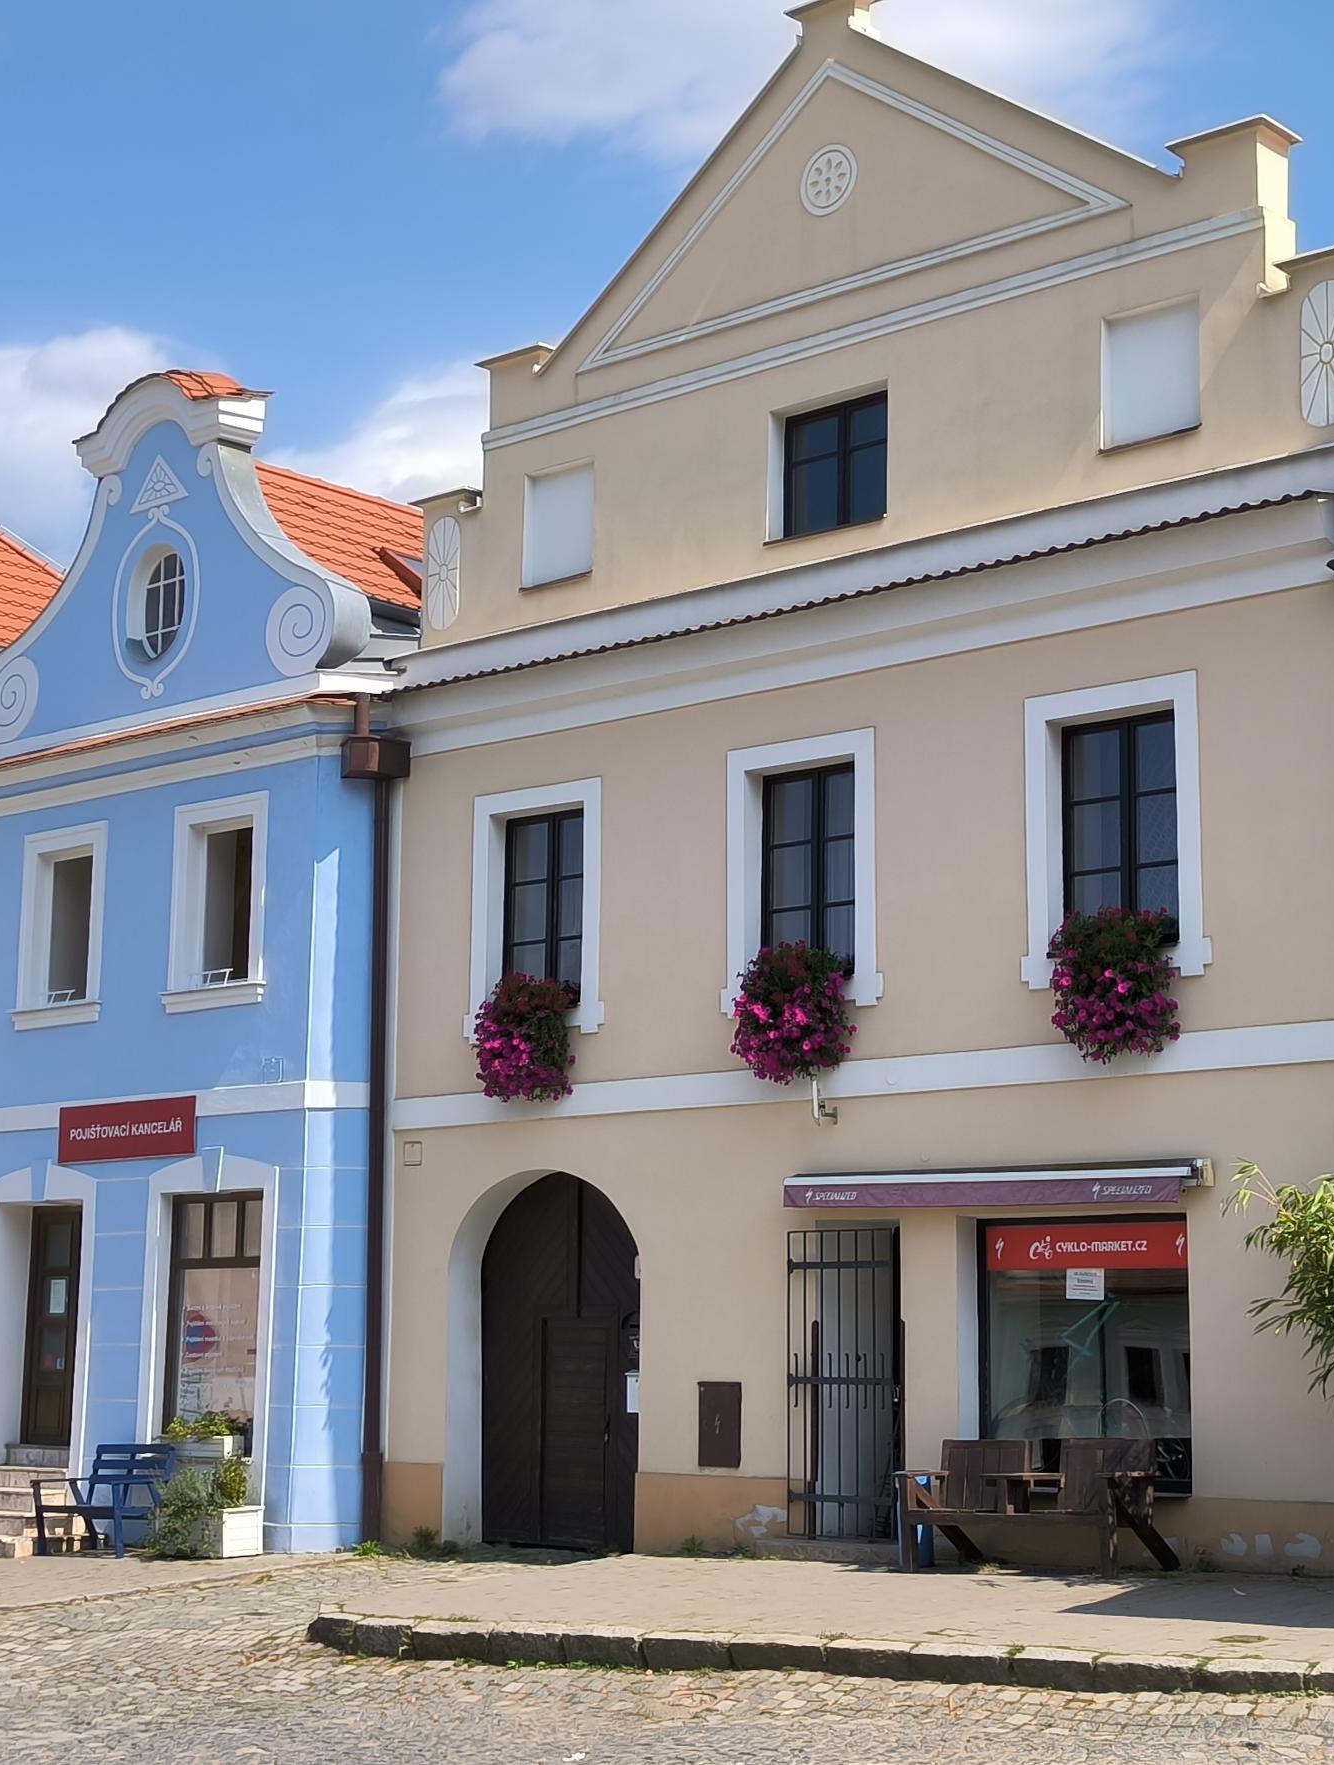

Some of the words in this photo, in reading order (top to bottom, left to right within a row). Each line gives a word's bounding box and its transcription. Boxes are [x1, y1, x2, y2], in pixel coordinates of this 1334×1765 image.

[69, 1121, 130, 1140] POJIŠŤOVACÍ
[131, 1117, 183, 1136] KANCELÁŘ
[1055, 1240, 1148, 1253] CYKLO-MARKET.CZ
